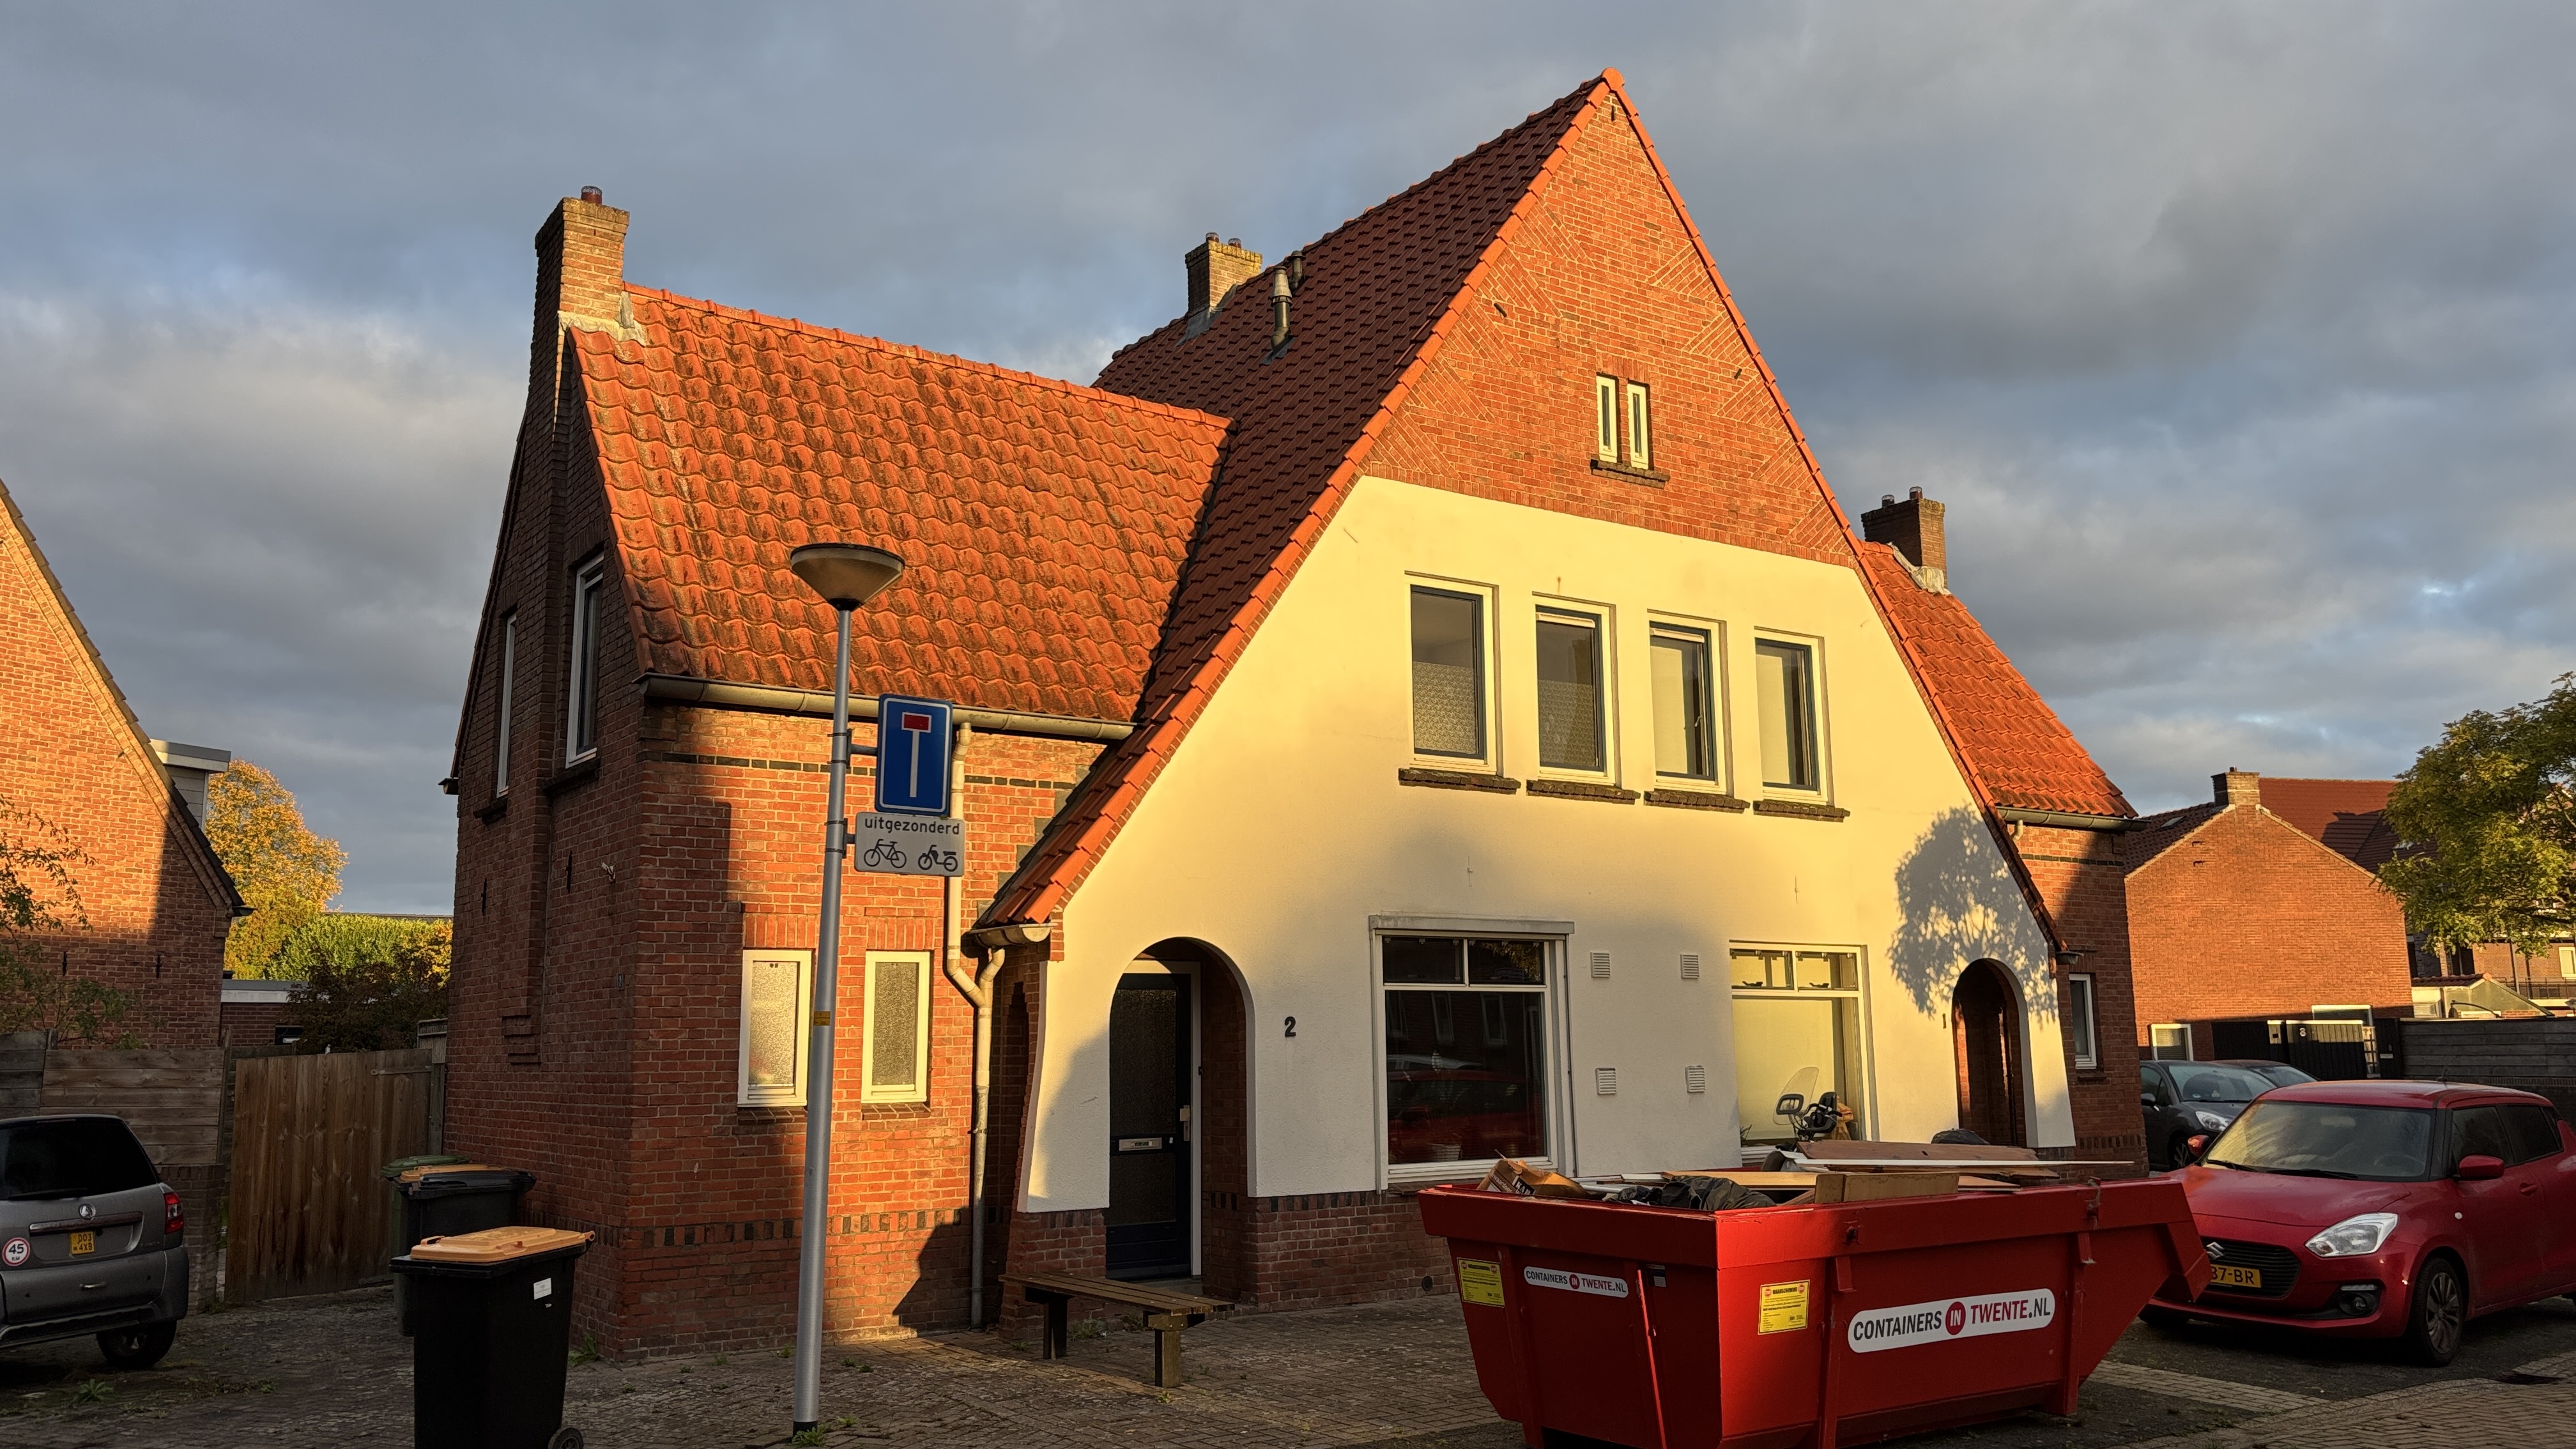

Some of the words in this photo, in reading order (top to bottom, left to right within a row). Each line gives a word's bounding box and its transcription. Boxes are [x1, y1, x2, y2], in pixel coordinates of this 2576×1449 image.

[864, 816, 960, 834] uitgezonderd
[1284, 1016, 1296, 1037] 2
[8, 1243, 24, 1254] 45
[1526, 1270, 1568, 1284] CONTAINERS
[1571, 1277, 1578, 1286] IN
[1581, 1277, 1627, 1292] TWENTE.NL
[1853, 1310, 1942, 1341] CONTAINERS
[1949, 1309, 1961, 1327] IN
[1970, 1297, 2051, 1324] TWENTE.NL
